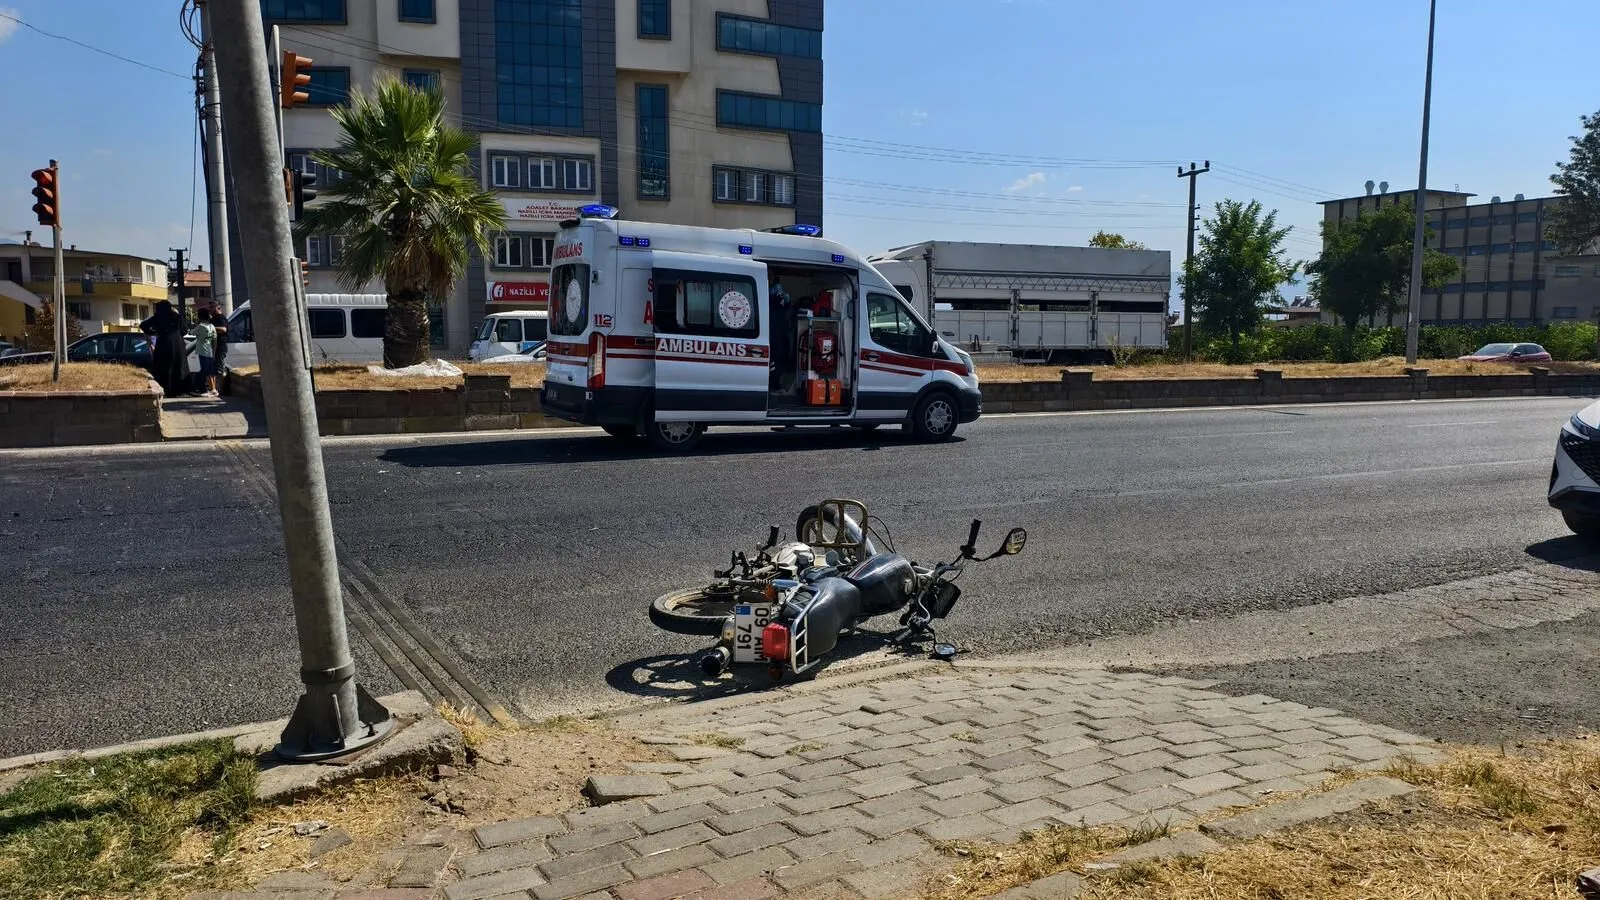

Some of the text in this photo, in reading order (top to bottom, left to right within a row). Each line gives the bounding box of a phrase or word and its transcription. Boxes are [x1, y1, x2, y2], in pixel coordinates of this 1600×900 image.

[594, 314, 612, 326] 112
[656, 338, 747, 357] AMBULANS
[754, 607, 769, 628] 09
[737, 624, 752, 650] 791
